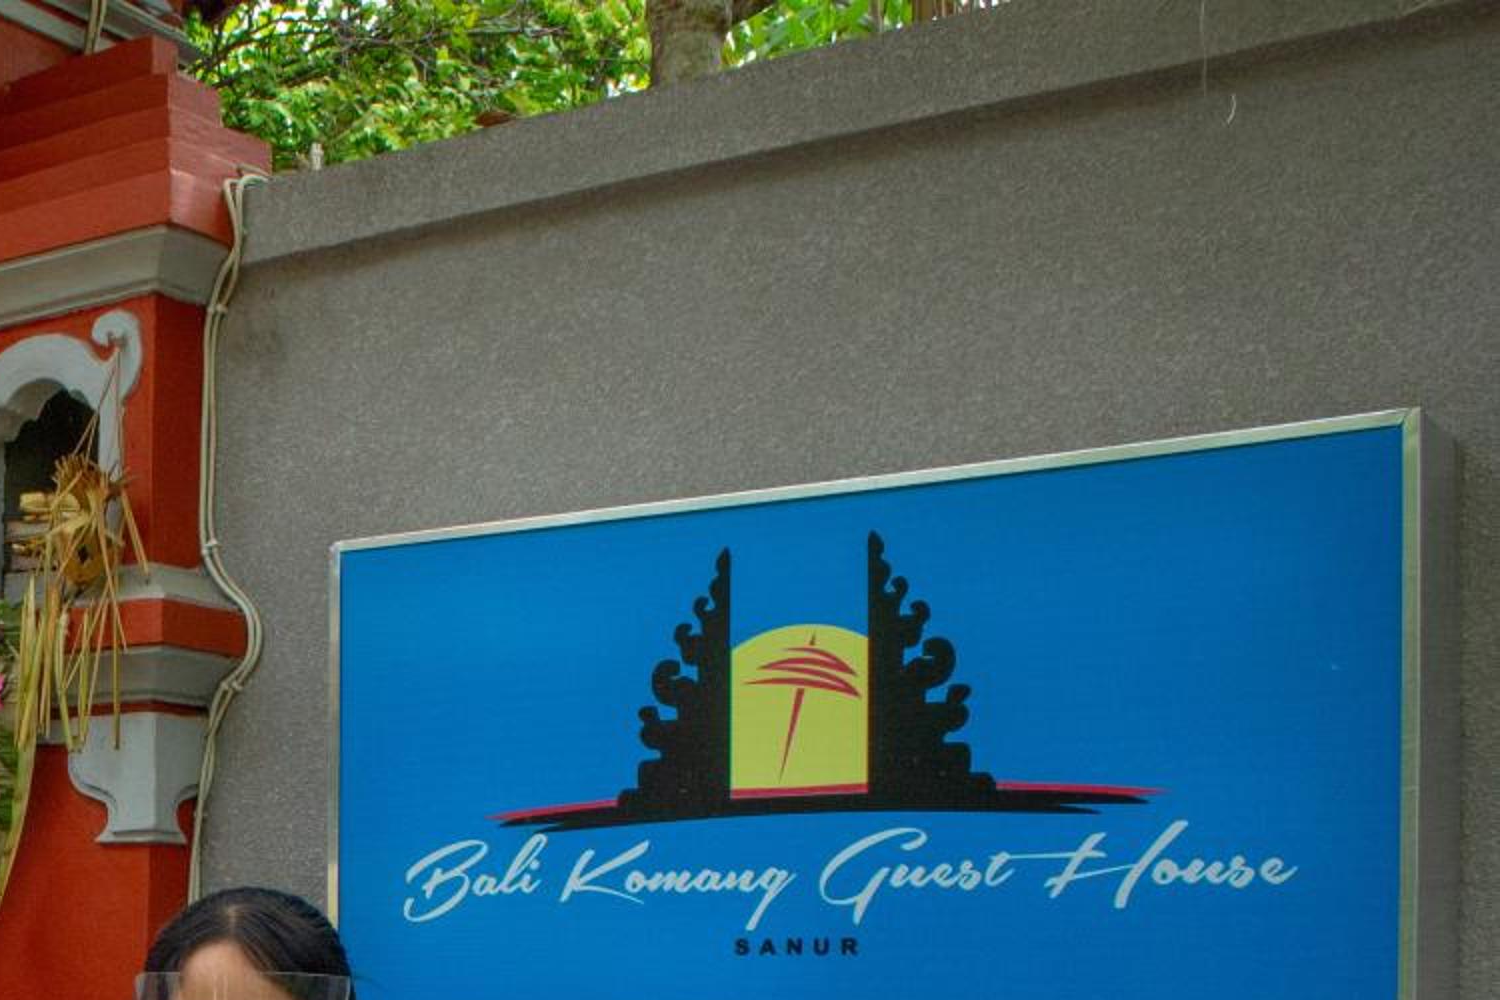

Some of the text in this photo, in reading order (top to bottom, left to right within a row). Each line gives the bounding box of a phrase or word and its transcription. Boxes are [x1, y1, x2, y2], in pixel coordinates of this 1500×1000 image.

[405, 820, 1297, 931] Bali Komang Guest House
[734, 936, 860, 957] SANUR
